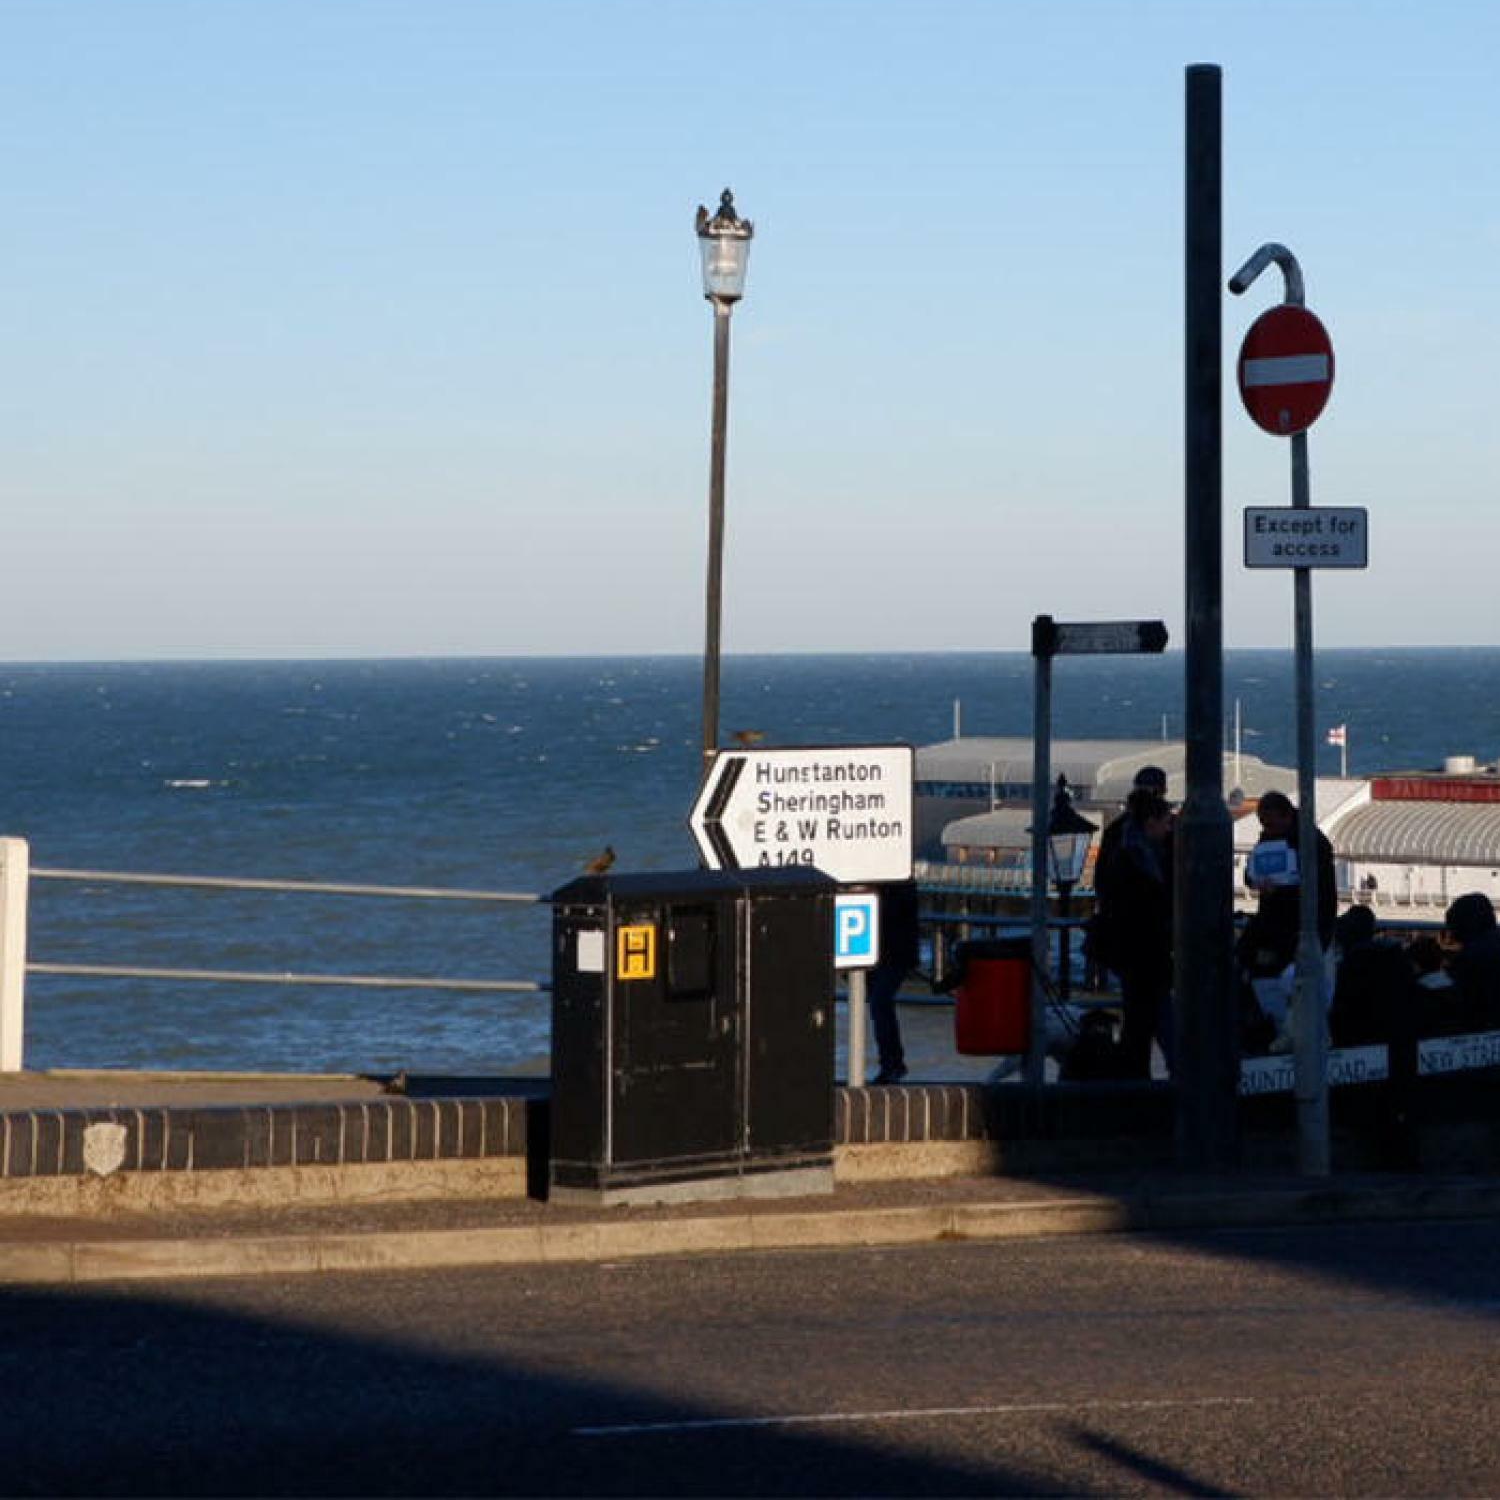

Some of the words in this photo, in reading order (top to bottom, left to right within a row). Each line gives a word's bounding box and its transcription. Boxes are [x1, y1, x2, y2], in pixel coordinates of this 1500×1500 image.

[1254, 515, 1323, 535] Except
[1330, 515, 1356, 534] for
[1272, 543, 1339, 556] access
[755, 761, 882, 784] Hunstanton
[757, 790, 886, 814] Sheringham
[754, 821, 767, 843] E
[775, 820, 789, 843] &
[797, 819, 818, 841] W
[826, 817, 903, 841] Runton
[840, 907, 867, 956] P
